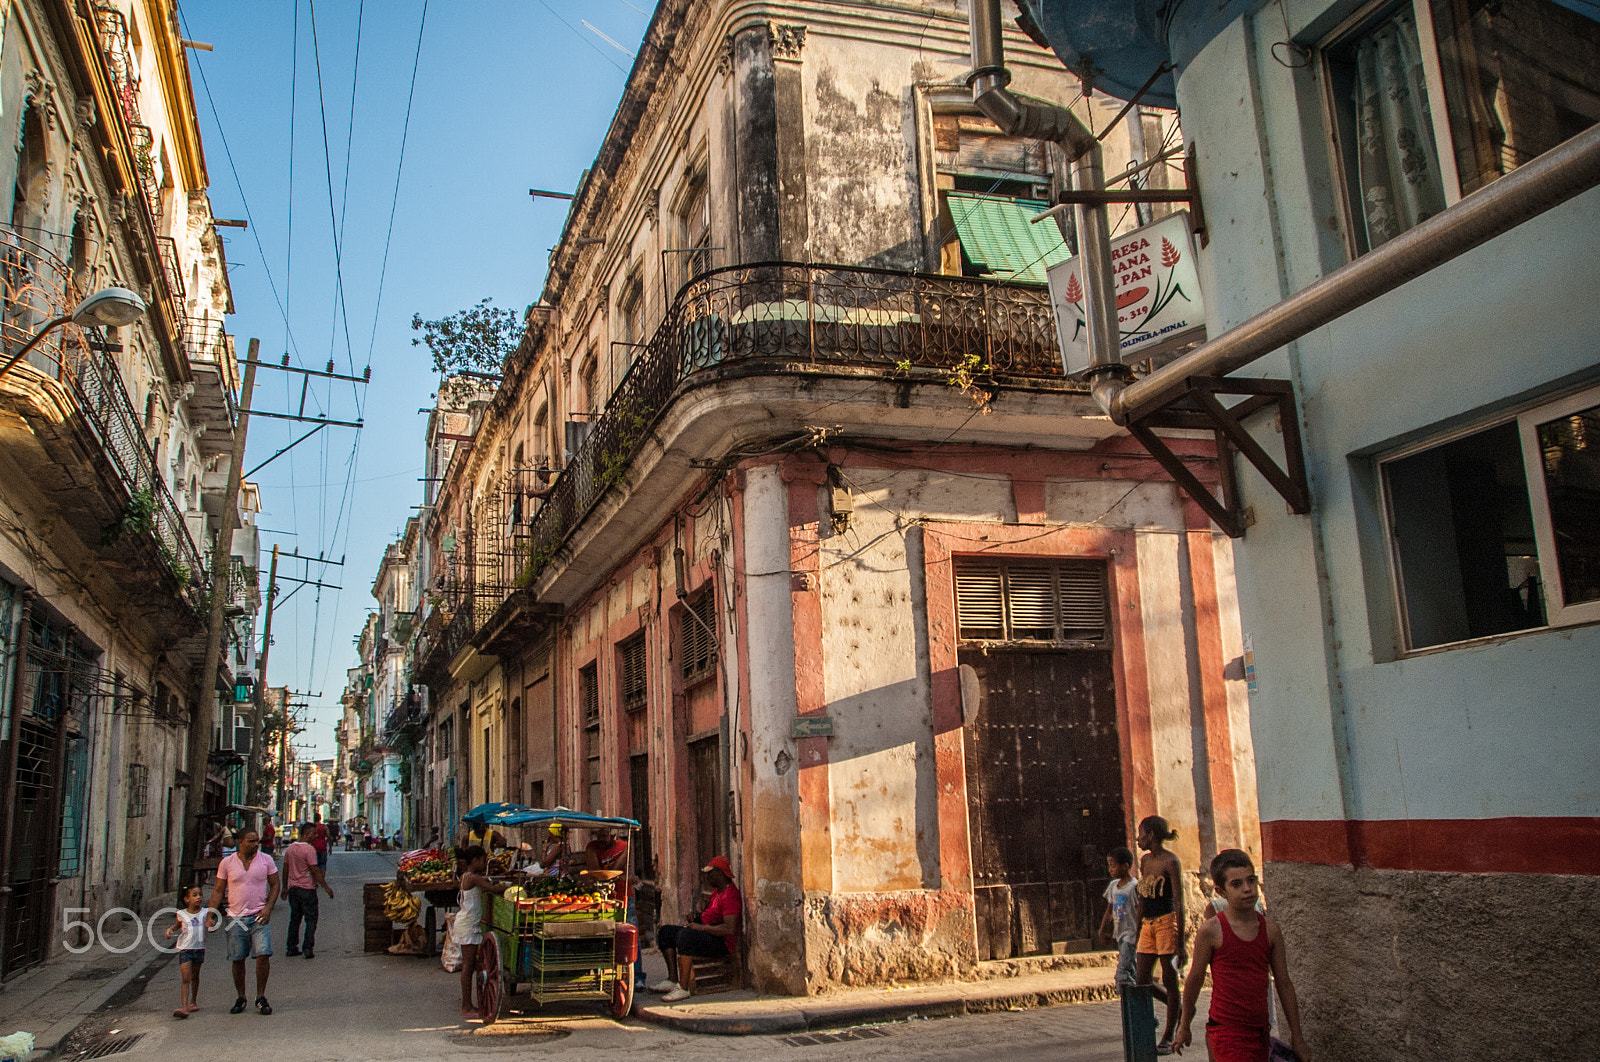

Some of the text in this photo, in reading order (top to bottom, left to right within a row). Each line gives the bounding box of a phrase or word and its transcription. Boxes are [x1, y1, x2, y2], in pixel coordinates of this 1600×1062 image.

[1121, 265, 1152, 286] PAN
[1130, 306, 1148, 319] 319
[1120, 320, 1188, 349] OLINERA-MINAL
